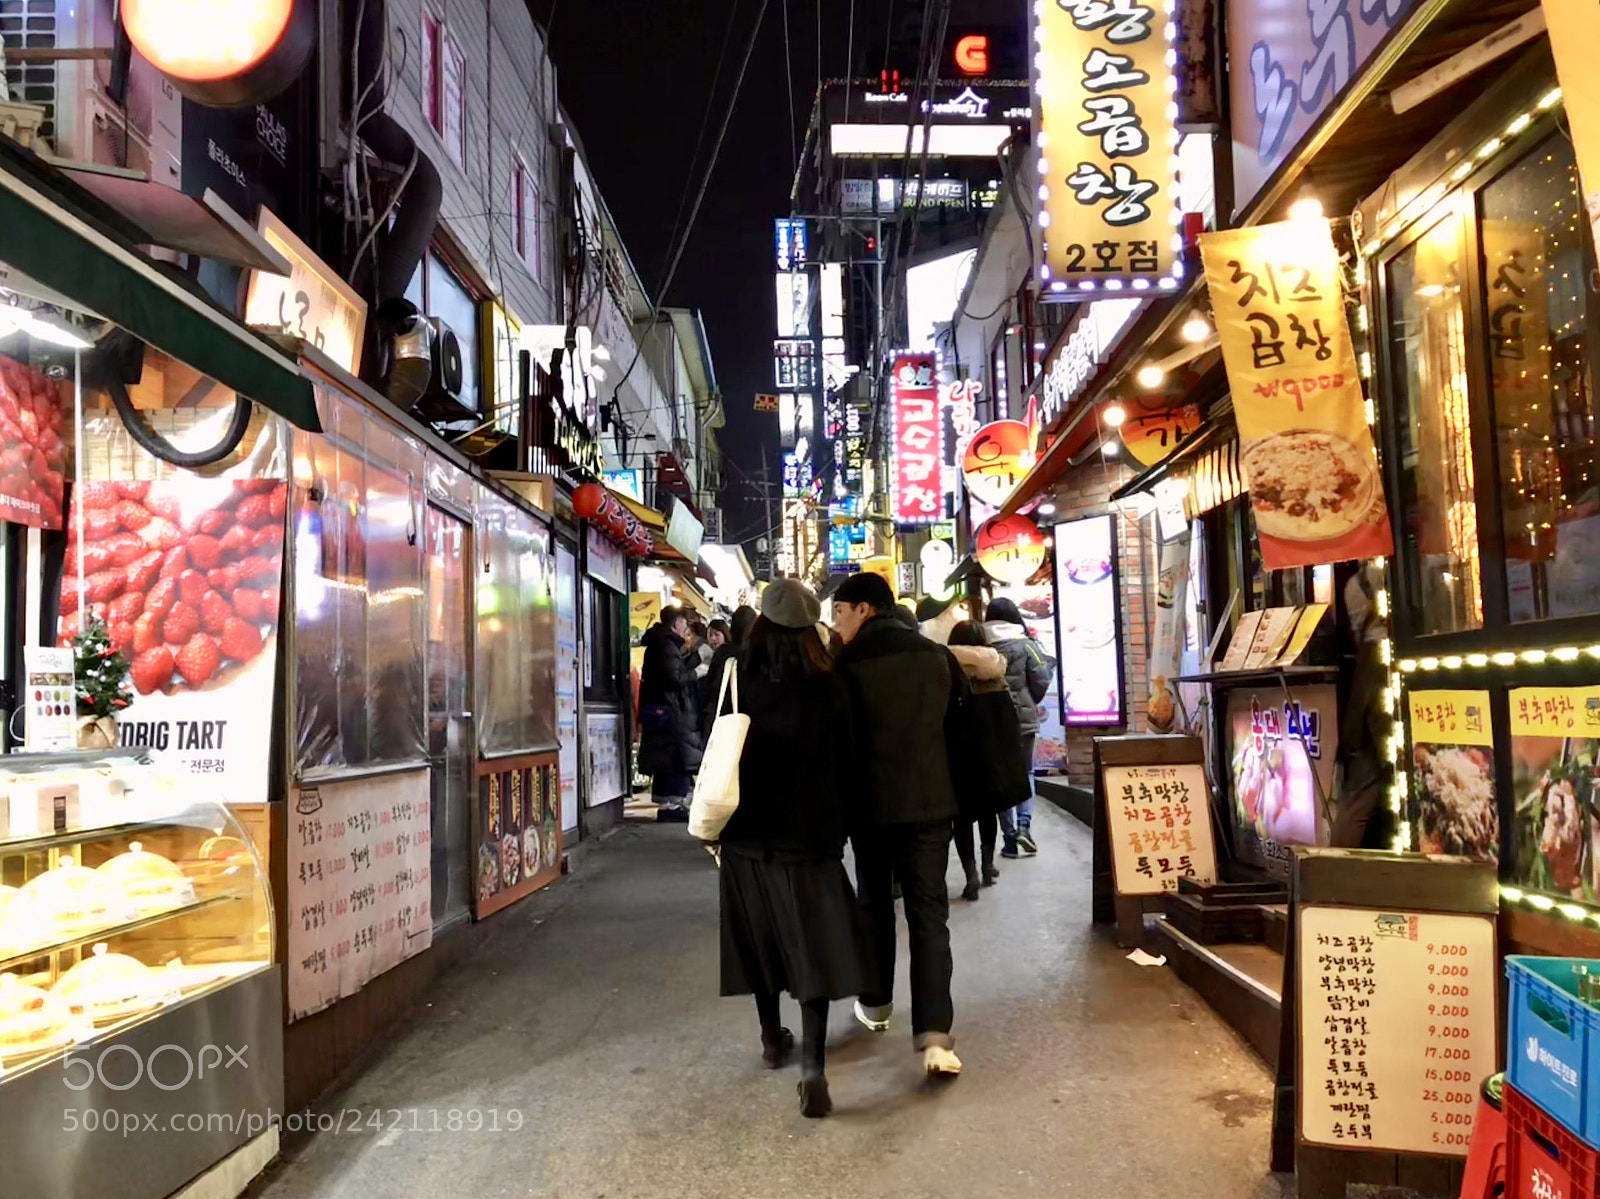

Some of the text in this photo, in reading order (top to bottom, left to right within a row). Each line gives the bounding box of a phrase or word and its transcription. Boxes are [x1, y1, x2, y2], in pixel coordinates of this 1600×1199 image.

[162, 79, 174, 101] LG
[256, 117, 287, 160] CHOICE
[1065, 240, 1160, 273] 2호점
[1227, 260, 1322, 307] 치즈
[1246, 312, 1332, 369] 곱창
[1414, 701, 1457, 732] 치즈곱창
[1518, 695, 1575, 728] 부추막창
[117, 720, 227, 751] DRIG TART
[190, 759, 225, 773] 전문점
[1122, 780, 1189, 803] 부추막창
[1124, 804, 1191, 827] 치즈곱창
[1128, 829, 1197, 853] 곱창전골
[1136, 856, 1196, 878] 특모듬
[1317, 933, 1468, 956] 치즈곱창 9.000
[1319, 955, 1469, 977] 양념막창 9.000
[1320, 975, 1469, 996] 부추막창 9.000
[1428, 1004, 1469, 1017] 9.000
[1324, 1015, 1470, 1039] 삼겹살 9.000
[1425, 1046, 1471, 1060] 17.000
[1327, 1058, 1471, 1082] 특모듬 15.000
[1539, 1048, 1578, 1087] 하이트진로
[1325, 1079, 1473, 1104] 곱창전골 25.000
[1431, 1112, 1472, 1125] 5.000
[1332, 1122, 1372, 1140] 순두부
